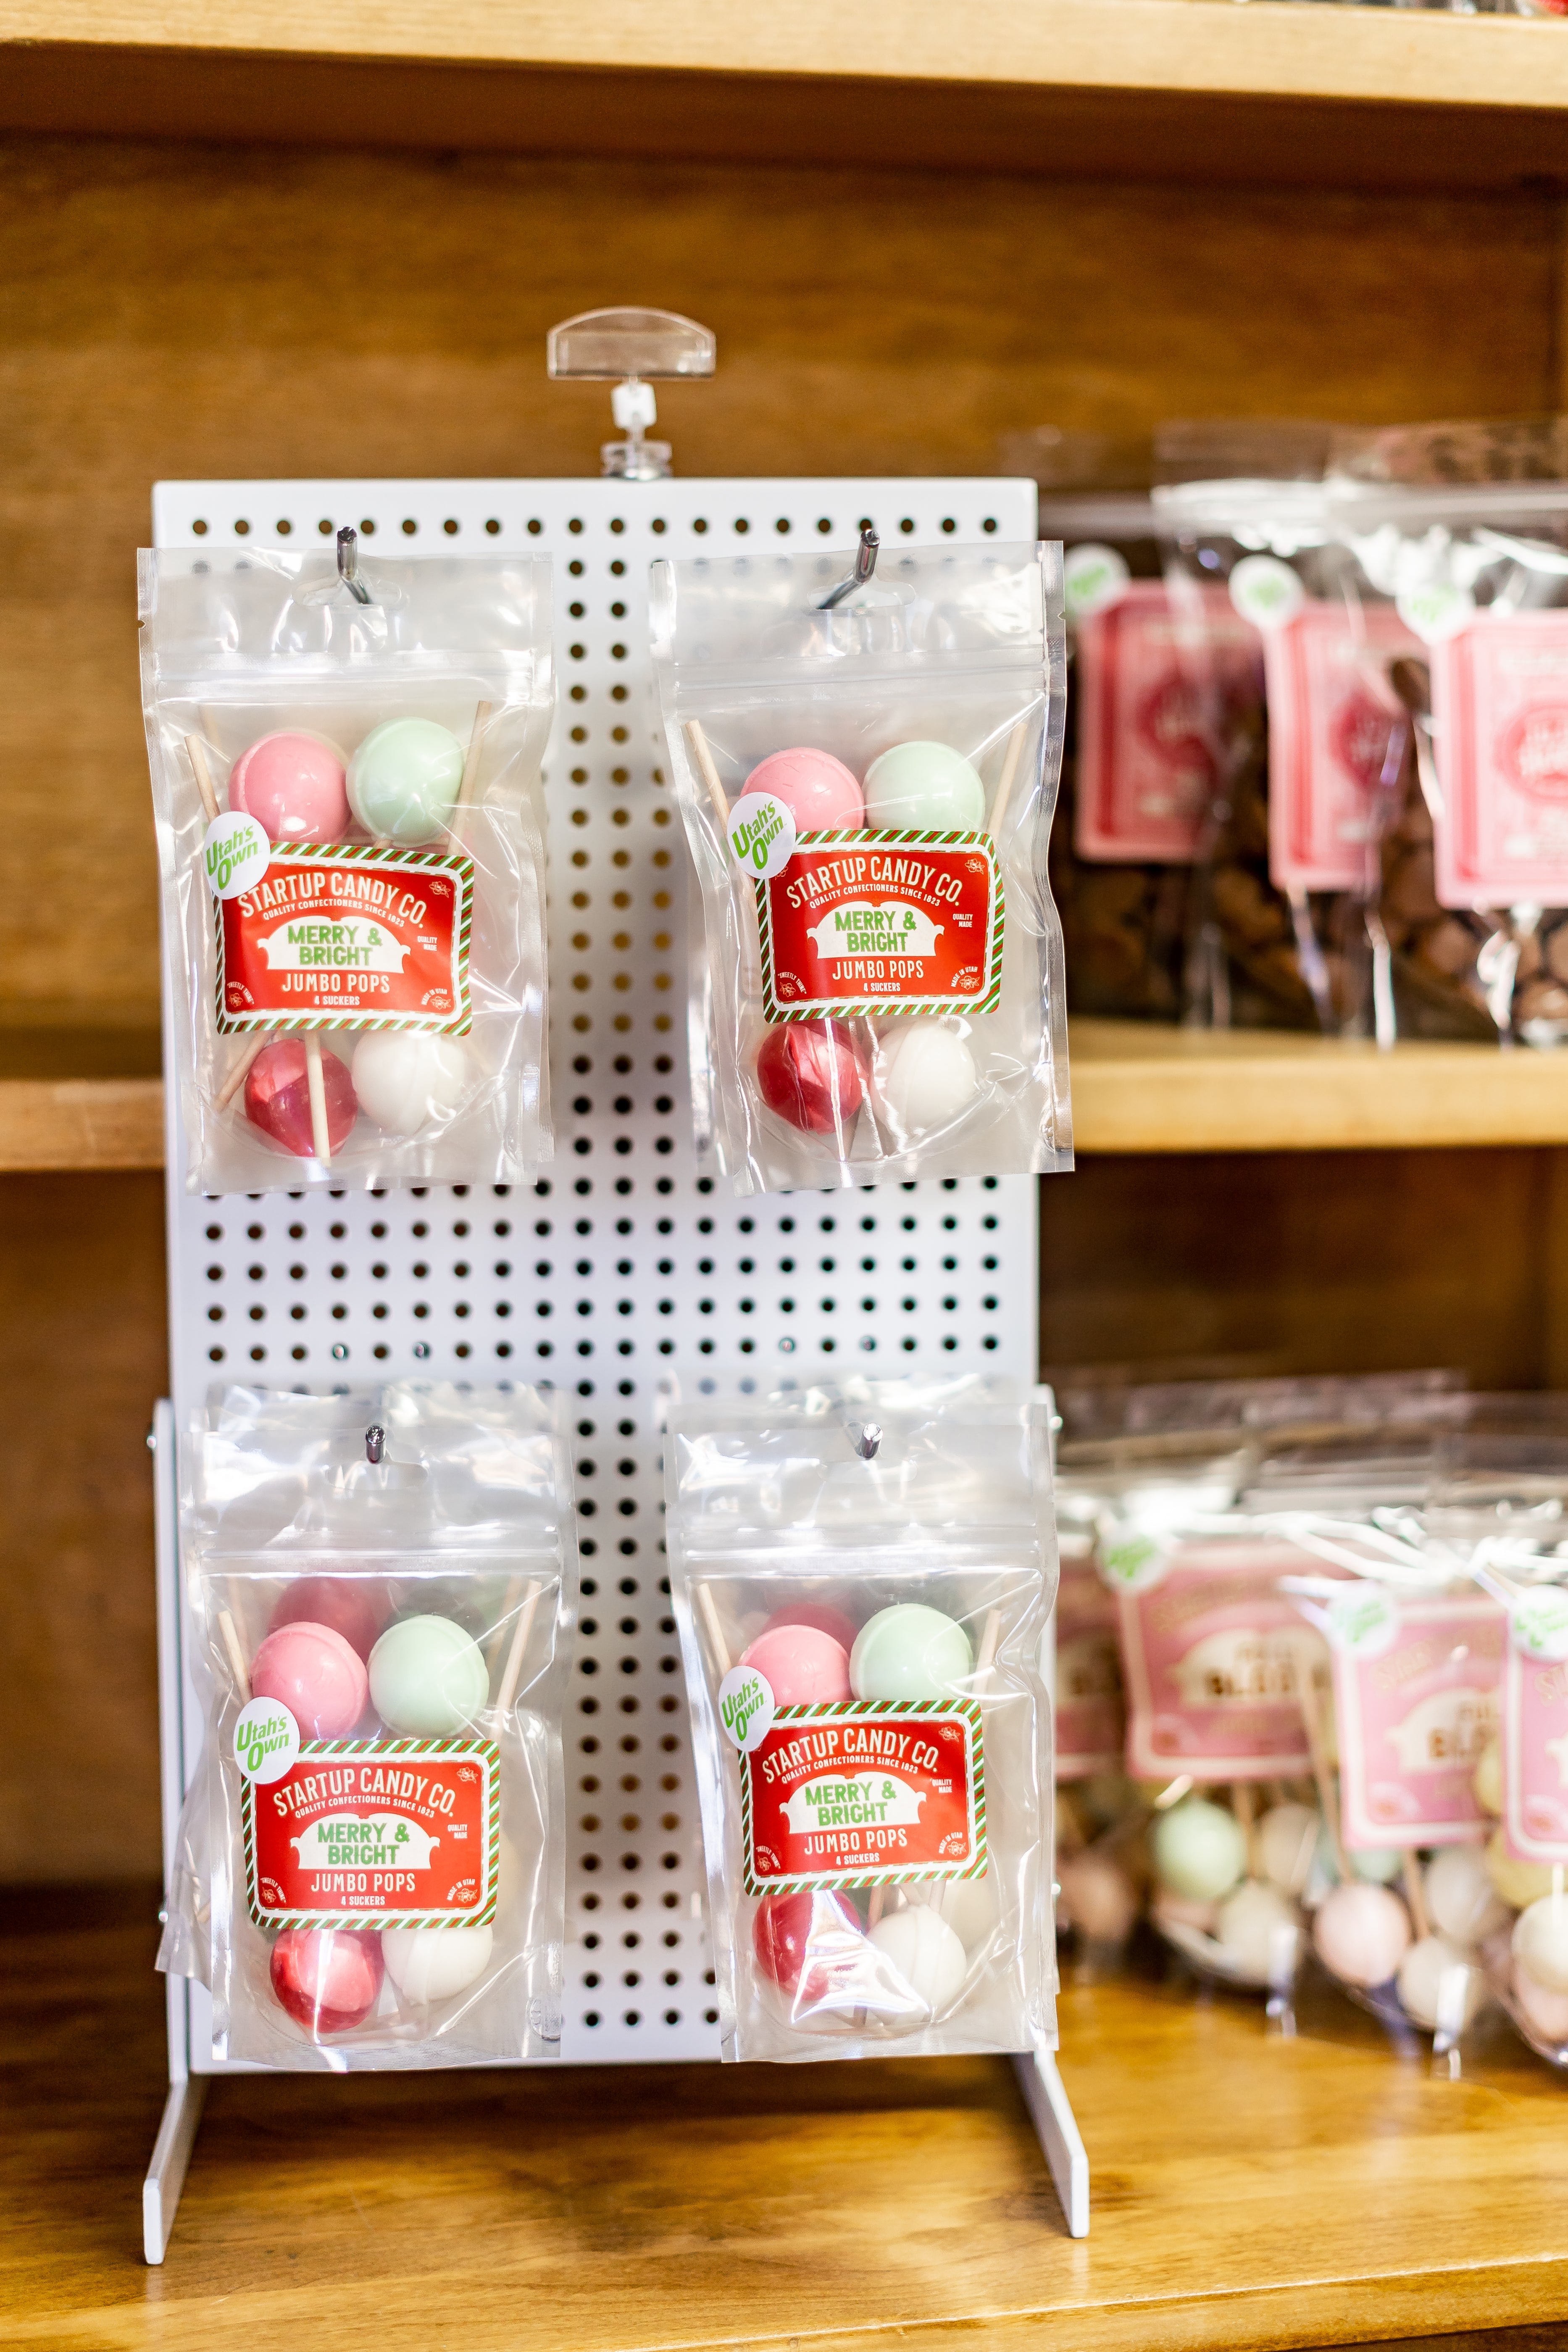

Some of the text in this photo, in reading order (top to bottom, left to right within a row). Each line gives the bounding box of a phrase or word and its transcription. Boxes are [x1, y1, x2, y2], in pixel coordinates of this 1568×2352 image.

[731, 800, 776, 860] Utah's
[206, 824, 253, 876] Utah's
[752, 815, 784, 871] Own
[217, 842, 258, 890] Own
[787, 856, 963, 908] STARTUP CANDY CO.
[238, 872, 427, 928] STARTUP CANDY CO.
[809, 884, 941, 909] QUALITY CONFECTIONERS SINCE 1823
[263, 898, 405, 927] QUALITY CONFECTIONERS SINCE 1823
[834, 911, 916, 931] MERRY &
[288, 926, 383, 946] MERRY &
[847, 933, 908, 952] BRIGHT
[299, 946, 373, 966] BRIGHT
[832, 960, 923, 980] JUMBO POPS
[951, 973, 960, 987] MADE
[282, 974, 390, 993] JUMBO POPS
[863, 982, 900, 992] 4 SUCKERS
[315, 996, 360, 1005] 4 SUCKERS
[421, 992, 431, 1005] MADE
[721, 1676, 759, 1728] Utah's
[736, 1692, 764, 1742] Own
[237, 1715, 287, 1752] Utah's
[247, 1733, 290, 1772] Own
[762, 1728, 939, 1784] STARTUP CANDY CO.
[781, 1756, 918, 1784] QUALITY CONFECTIONERS SINCE 1823
[273, 1768, 456, 1818] STARTUP CANDY CO.
[805, 1780, 896, 1805] MERRY &
[295, 1795, 434, 1819] QUALITY CONFECTIONERS SINCE 1823
[818, 1802, 888, 1826] BRIGHT
[318, 1823, 410, 1843] MERRY &
[804, 1828, 908, 1855] JUMBO POPS
[328, 1845, 400, 1865] BRIGHT
[938, 1839, 947, 1854] MADE
[836, 1853, 880, 1866] 4 SUCKERS
[311, 1873, 415, 1892] JUMBO POPS
[447, 1886, 457, 1901] MADE
[341, 1896, 385, 1905] 4 SUCKERS
